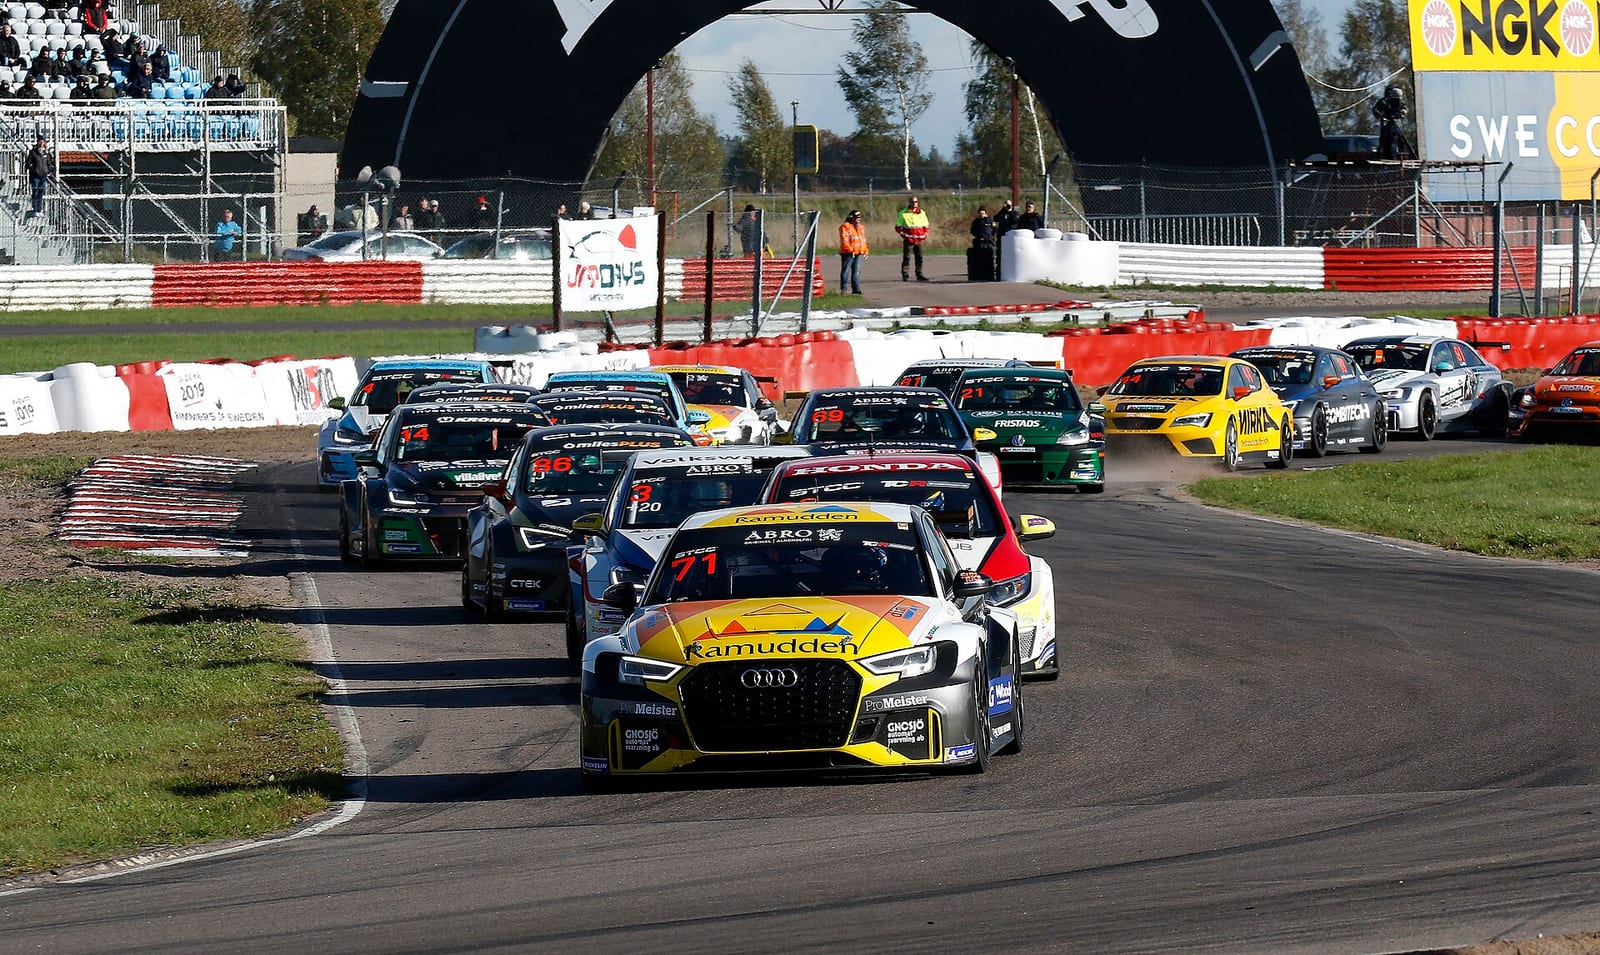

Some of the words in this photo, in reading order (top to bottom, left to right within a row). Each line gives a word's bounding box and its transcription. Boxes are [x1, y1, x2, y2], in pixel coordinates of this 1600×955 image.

[1427, 14, 1450, 28] NGK
[1566, 15, 1588, 28] NGK
[1461, 0, 1561, 58] NGK
[1452, 346, 1466, 362] 91
[371, 373, 415, 382] STCC
[965, 377, 1007, 385] STCC
[180, 382, 205, 401] 2019
[960, 387, 984, 399] 21
[811, 409, 845, 423] 69
[1238, 407, 1280, 435] MIRKA
[994, 420, 1041, 428] FRISTADS
[400, 427, 430, 442] 14
[542, 431, 681, 441] CUPRA
[533, 456, 572, 473] 86
[791, 462, 965, 476] HONDA
[630, 484, 653, 502] 3
[789, 481, 864, 497] STCC
[735, 512, 858, 524] Ramudden
[675, 546, 719, 559] STCC
[671, 552, 717, 582] 71
[510, 579, 541, 589] CTEK
[685, 637, 859, 662] Ramudden
[619, 702, 678, 716] ProMeister
[865, 695, 928, 712] ProMeister
[625, 728, 659, 742] GNOSJÖ
